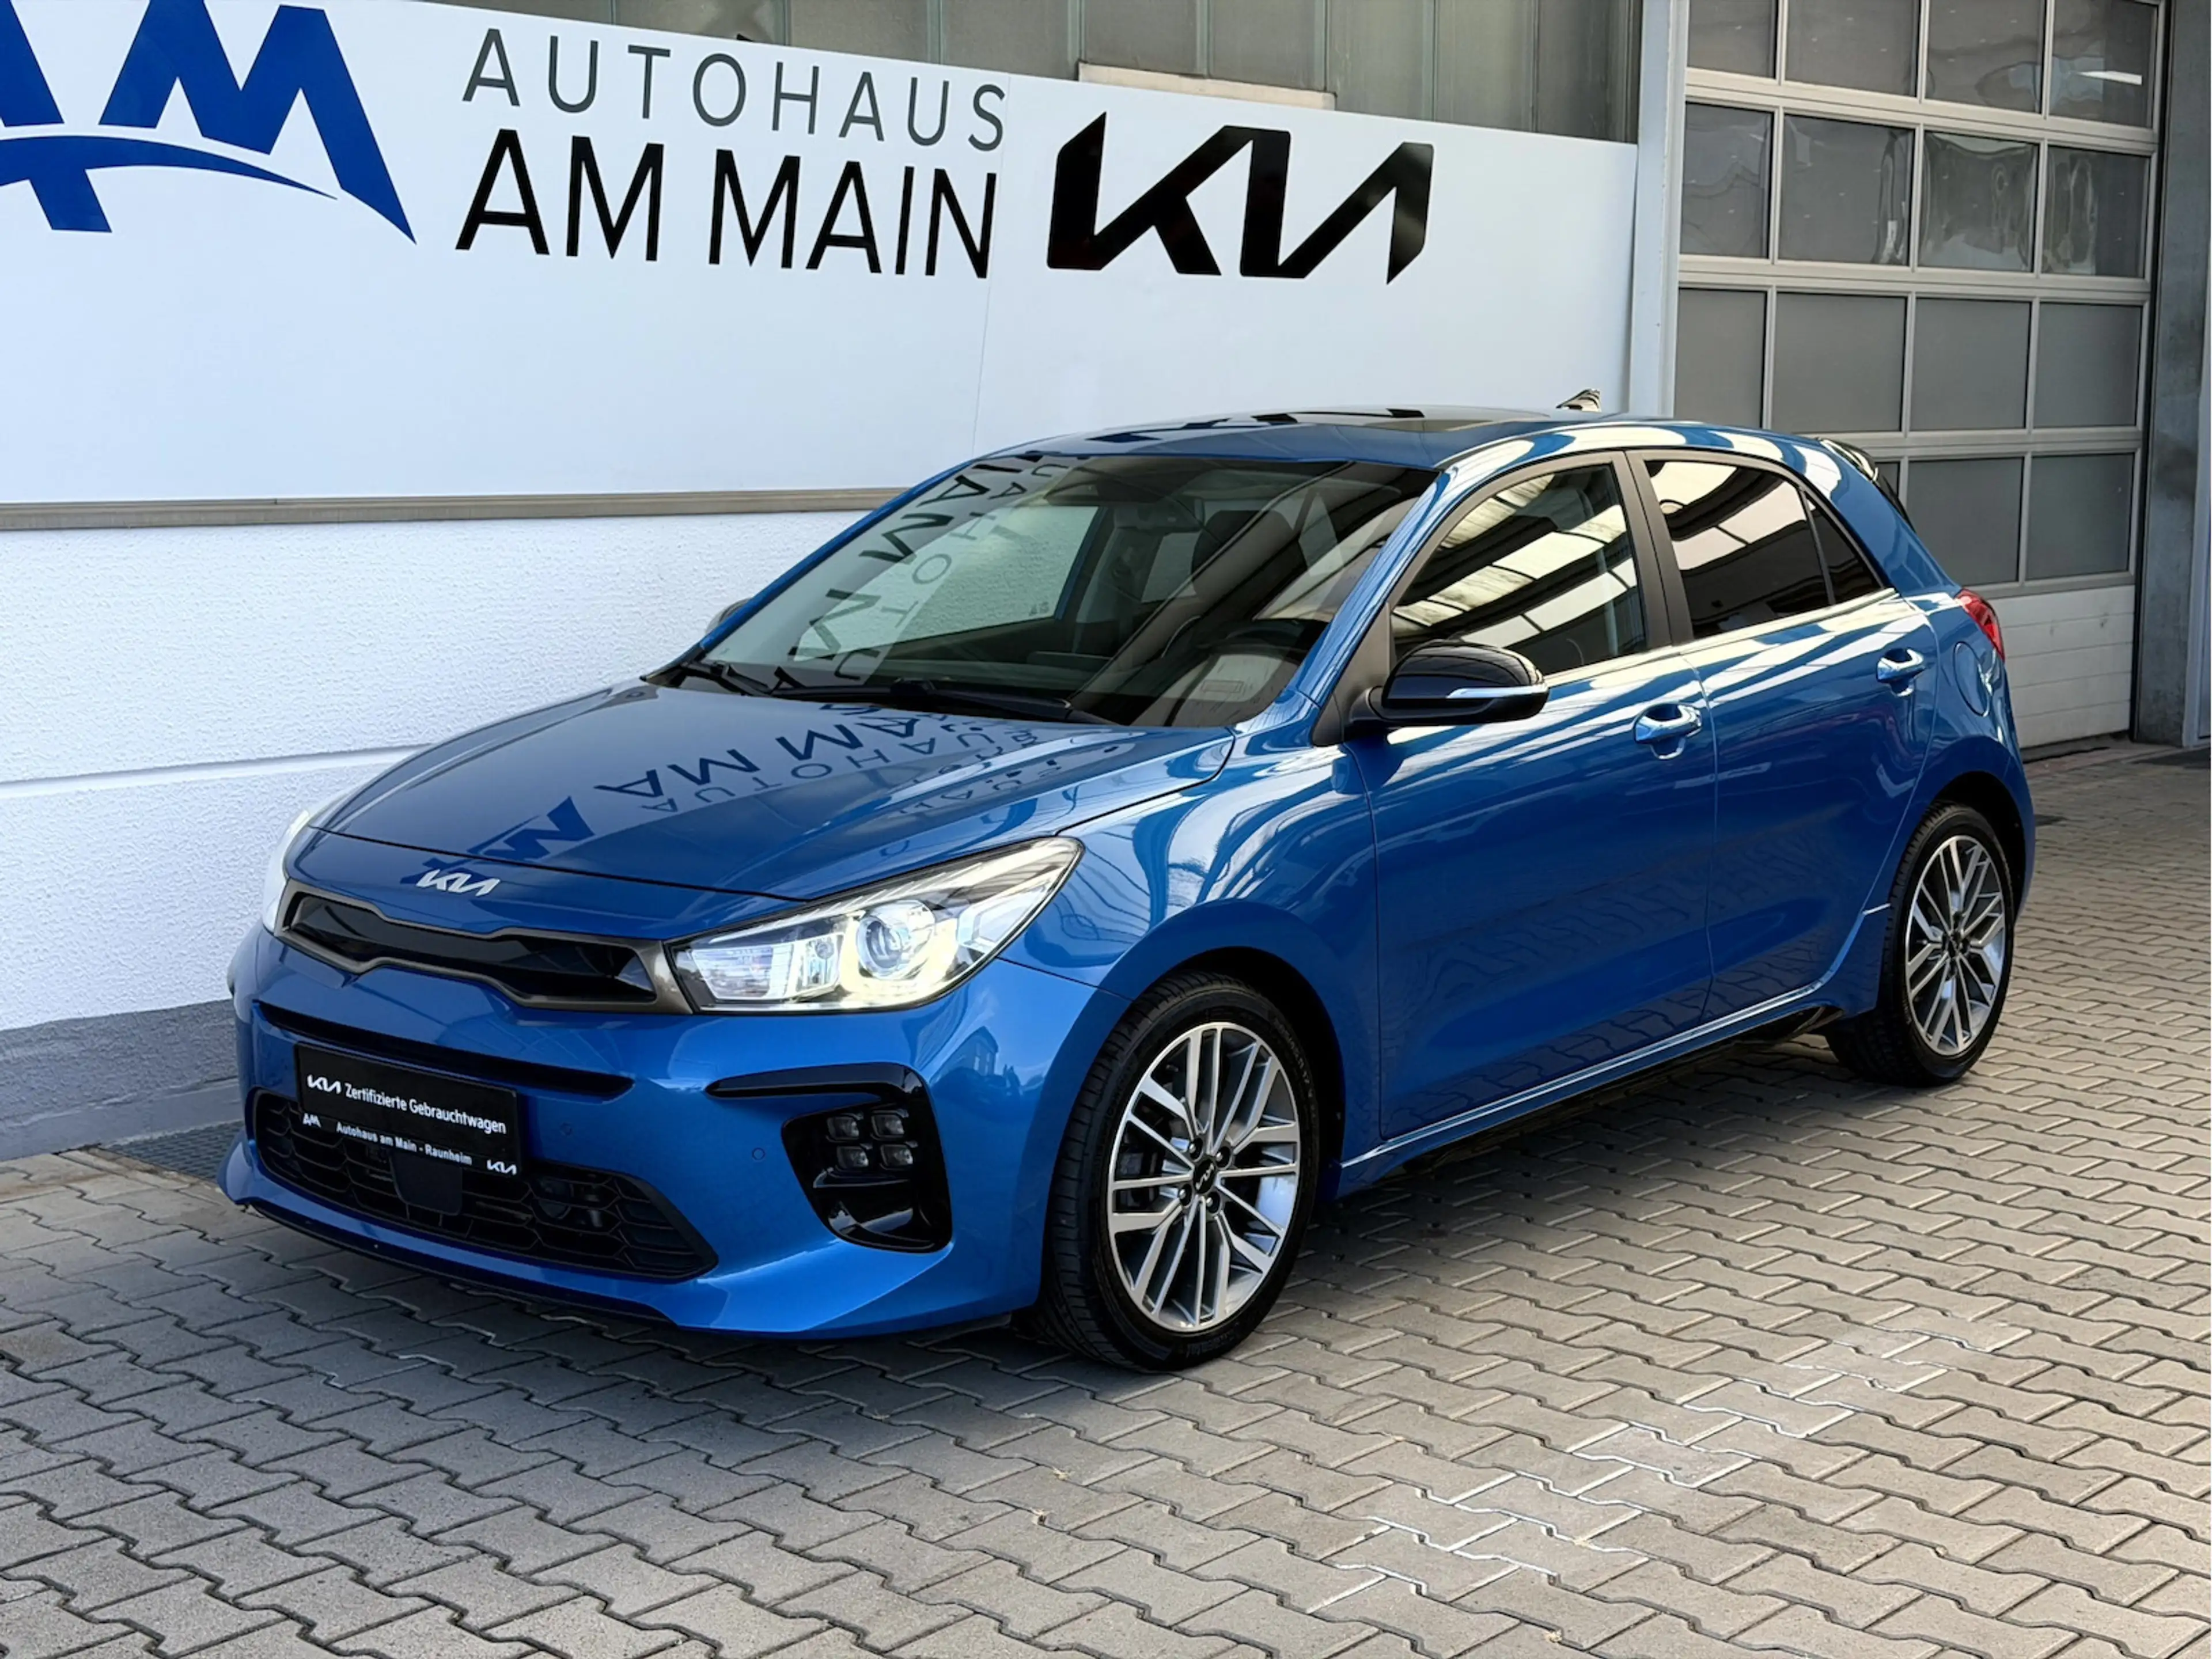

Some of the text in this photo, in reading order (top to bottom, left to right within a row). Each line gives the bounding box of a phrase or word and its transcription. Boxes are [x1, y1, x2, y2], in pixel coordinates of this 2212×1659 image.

[462, 28, 1005, 151] AUTOHAUS
[454, 128, 997, 279] AM MAIN
[1047, 111, 1434, 285] KIA
[415, 869, 500, 896] KIA
[306, 1074, 507, 1135] KIA Zertifizierte Gebrauchtwagen
[336, 1122, 378, 1143] Autohaus
[380, 1134, 394, 1146] am
[395, 1137, 417, 1153] Main
[425, 1143, 472, 1166] Raunheim
[487, 1160, 517, 1176] KIA
